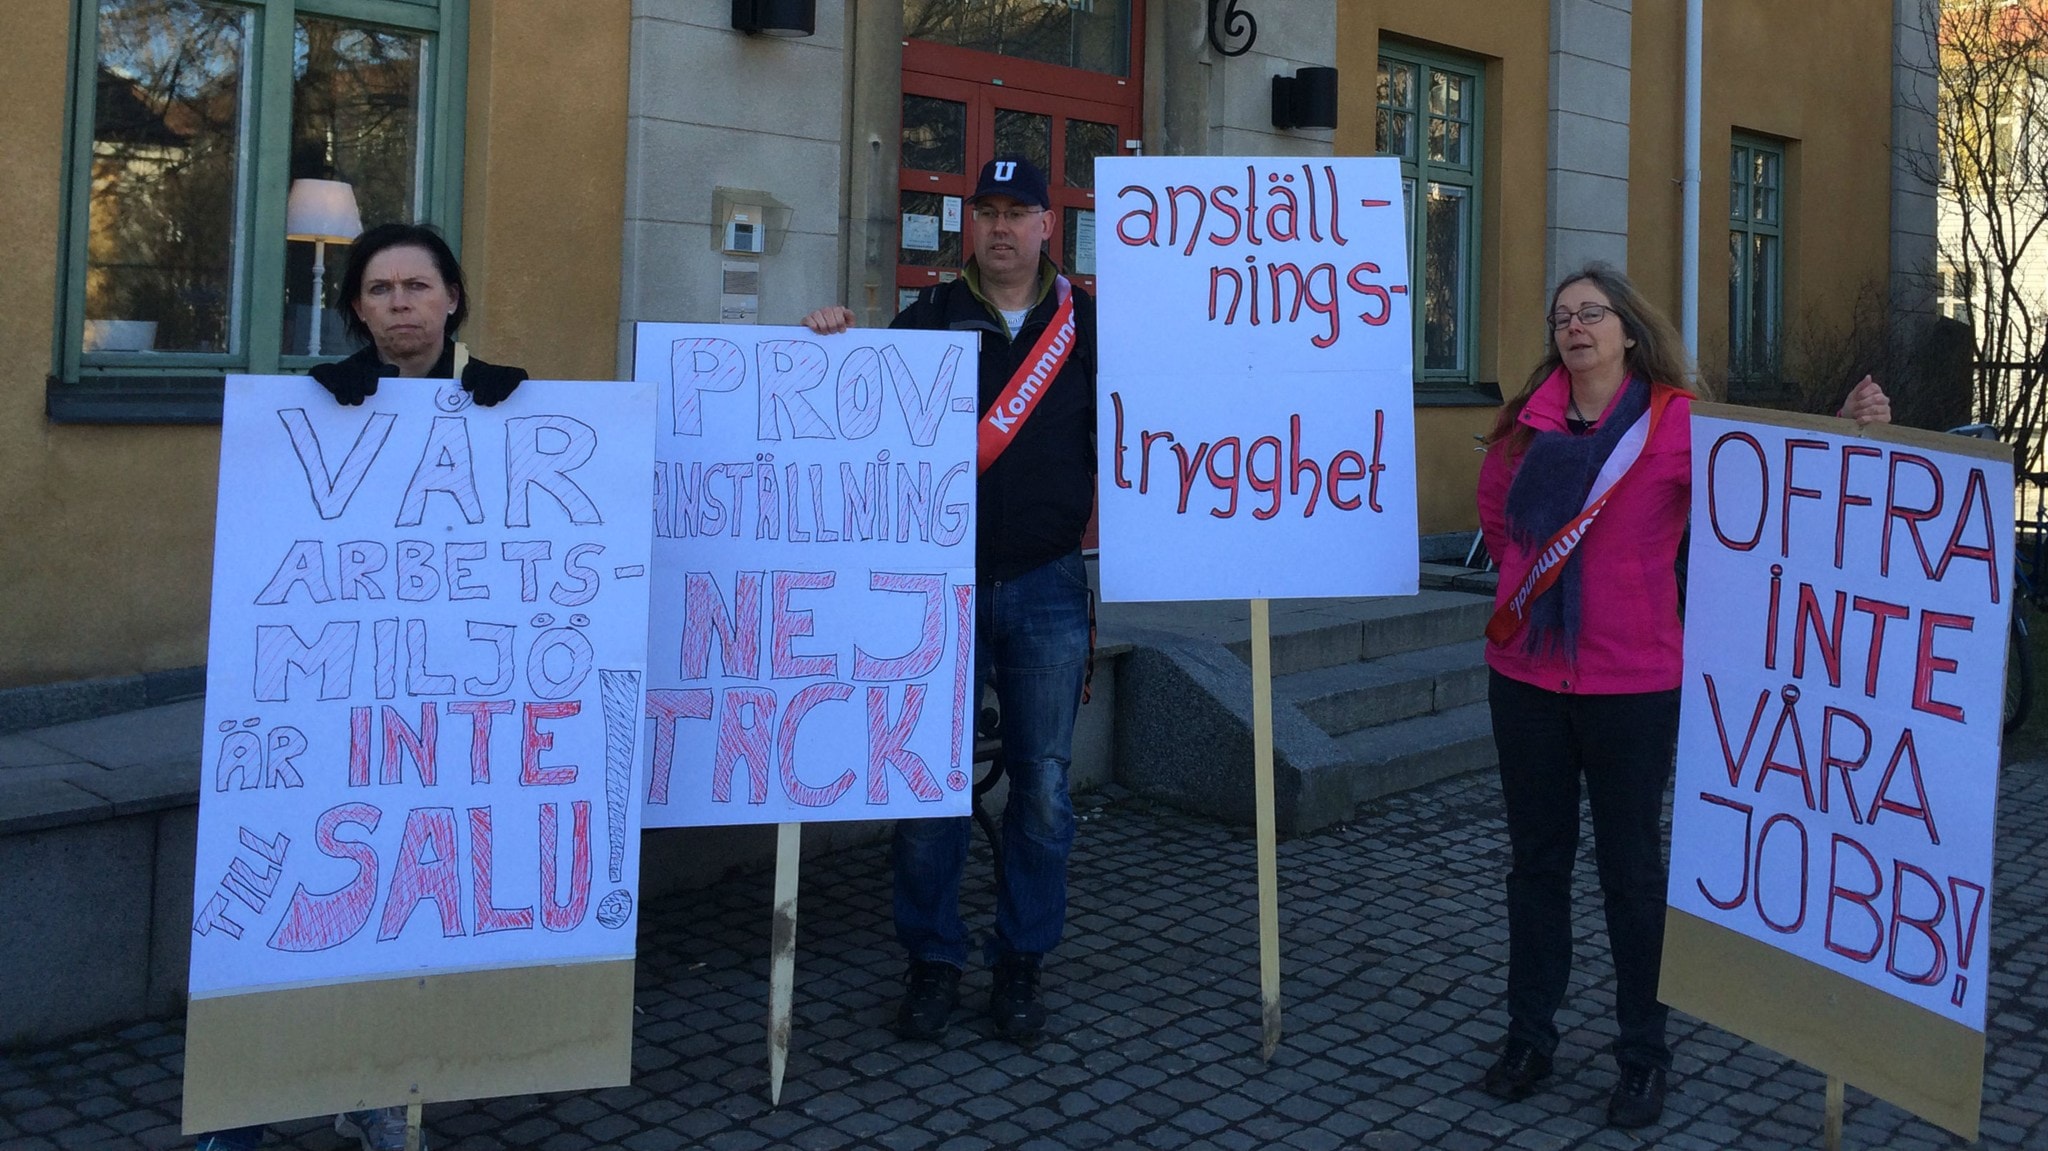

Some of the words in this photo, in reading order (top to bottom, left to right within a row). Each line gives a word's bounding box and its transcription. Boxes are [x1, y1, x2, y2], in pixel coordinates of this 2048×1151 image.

[993, 161, 1017, 182] U
[1116, 164, 1392, 256] anställ-
[1208, 255, 1408, 348] nings-
[671, 337, 976, 447] PROV-
[988, 296, 1076, 434] Kommun
[277, 384, 605, 528] VÅR
[1110, 391, 1386, 521] trygghet
[253, 540, 645, 606] ARBETS-
[1707, 430, 2000, 604] OFFRA
[253, 613, 595, 702] MILJÖ
[1765, 564, 1975, 724] INTE
[216, 717, 308, 792] ÄR
[348, 700, 582, 787] INTE
[1702, 672, 1941, 846] VÅRA
[193, 826, 292, 941] TILL
[1696, 791, 1986, 1008] JOBB!
